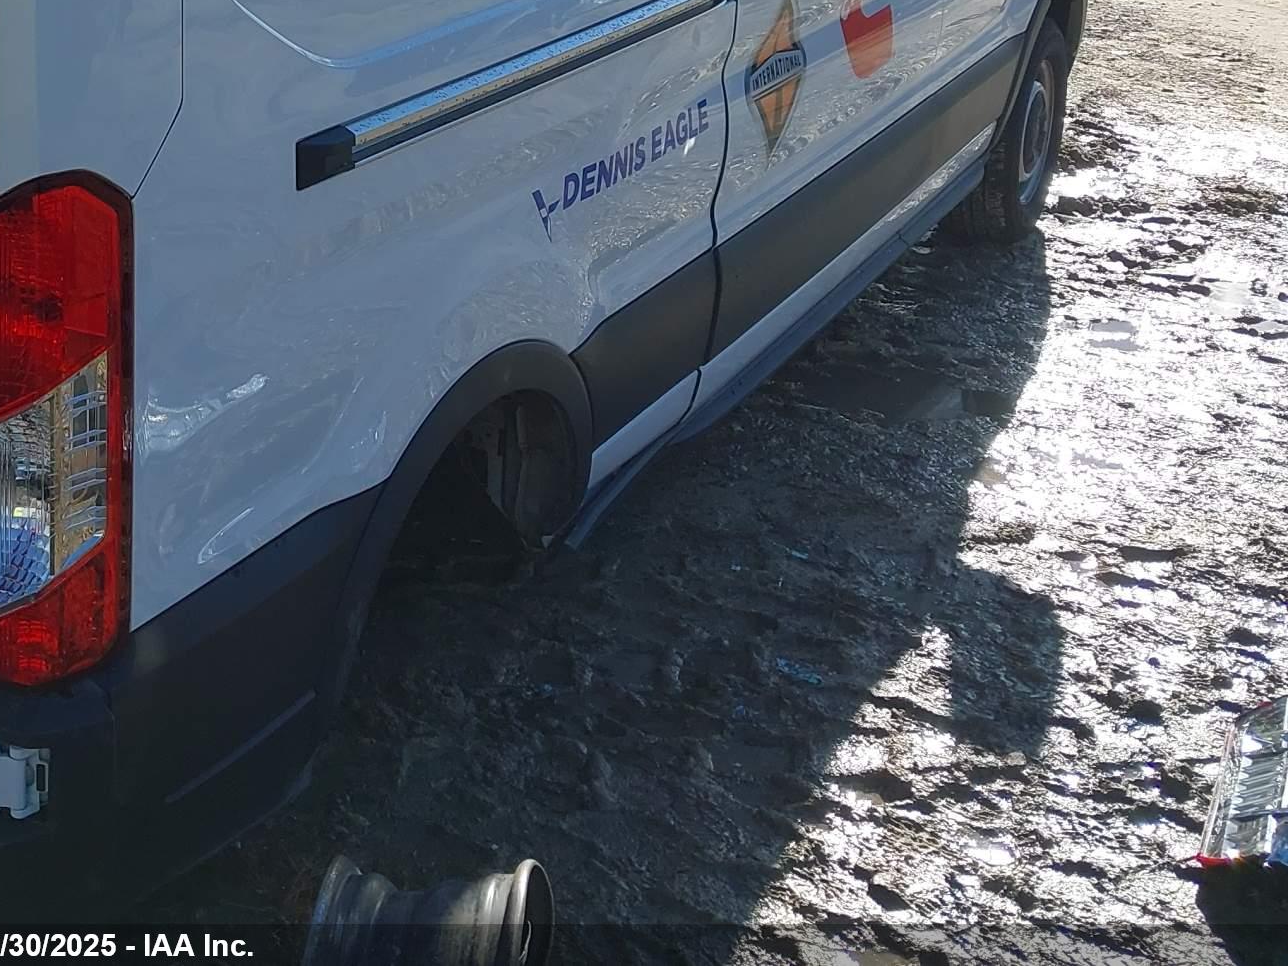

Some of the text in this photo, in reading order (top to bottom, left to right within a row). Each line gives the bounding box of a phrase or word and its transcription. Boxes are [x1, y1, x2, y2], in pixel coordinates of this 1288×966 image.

[752, 54, 802, 91] INTERNATIONAL
[563, 98, 710, 211] DENNIS EAGLE
